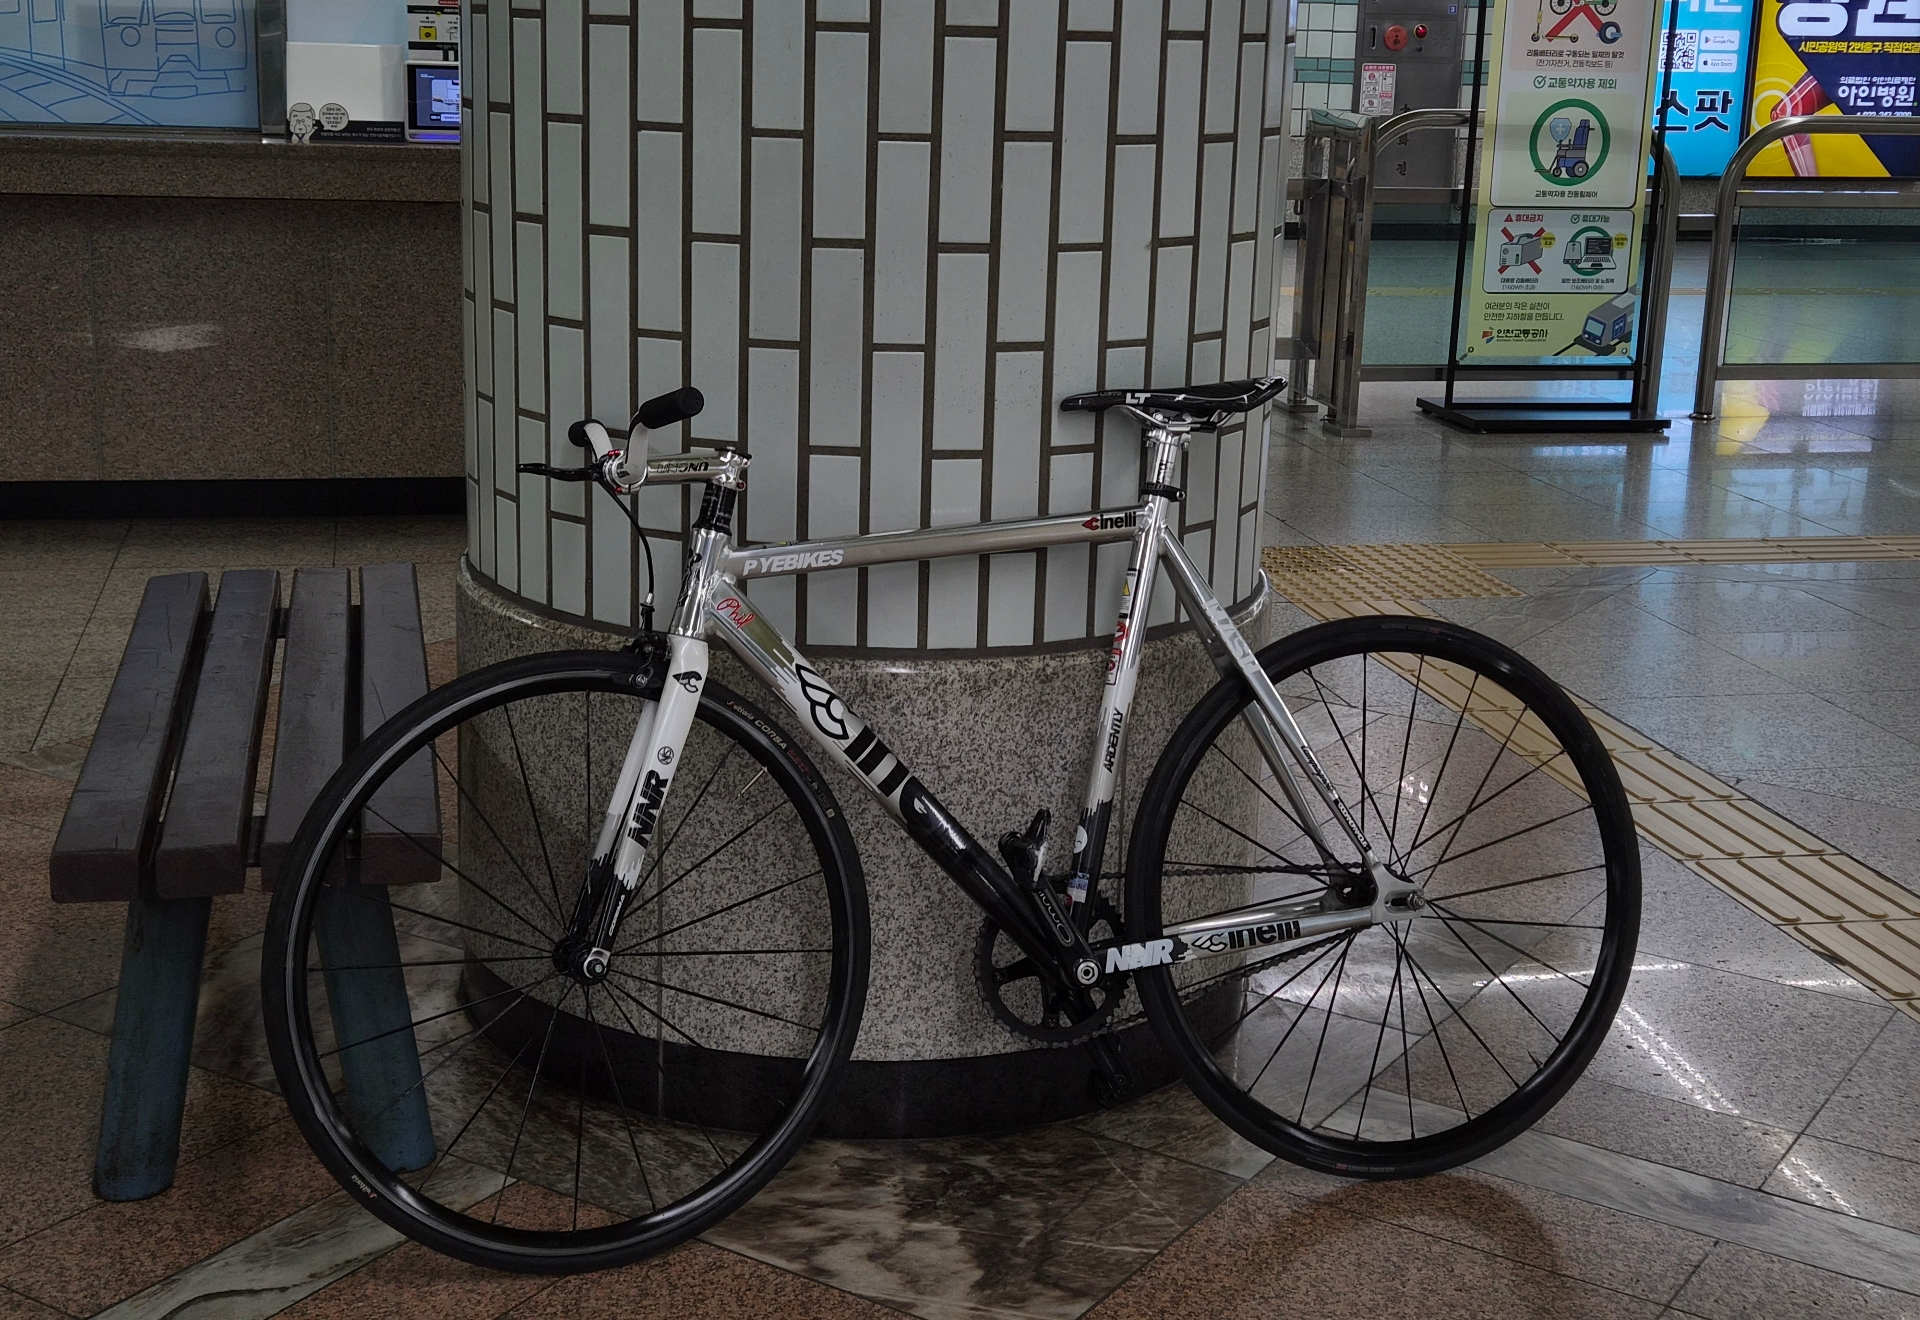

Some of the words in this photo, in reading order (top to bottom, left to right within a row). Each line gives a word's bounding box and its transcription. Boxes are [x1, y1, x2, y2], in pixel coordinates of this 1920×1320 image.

[1798, 41, 1848, 53] 시민공원역
[1565, 50, 1590, 58] 구동되는
[1547, 77, 1596, 89] 교통약자용
[1598, 78, 1617, 89] 제외
[1535, 190, 1566, 198] 교통약자용
[1567, 190, 1598, 198] 전동휠체어
[1515, 213, 1544, 222] 휴대금지
[1581, 214, 1610, 223] 휴대가능
[1484, 302, 1513, 310] 여러분의
[1514, 302, 1528, 310] 작은
[1529, 302, 1550, 310] 실천이
[1483, 312, 1505, 321] 안전한
[1506, 312, 1533, 321] 지하철을
[1534, 313, 1564, 321] 만듭니다.
[1496, 328, 1549, 338] 인천교통공사
[1125, 392, 1151, 405] LT
[1202, 598, 1262, 675] MASH
[754, 720, 787, 750] CORSA
